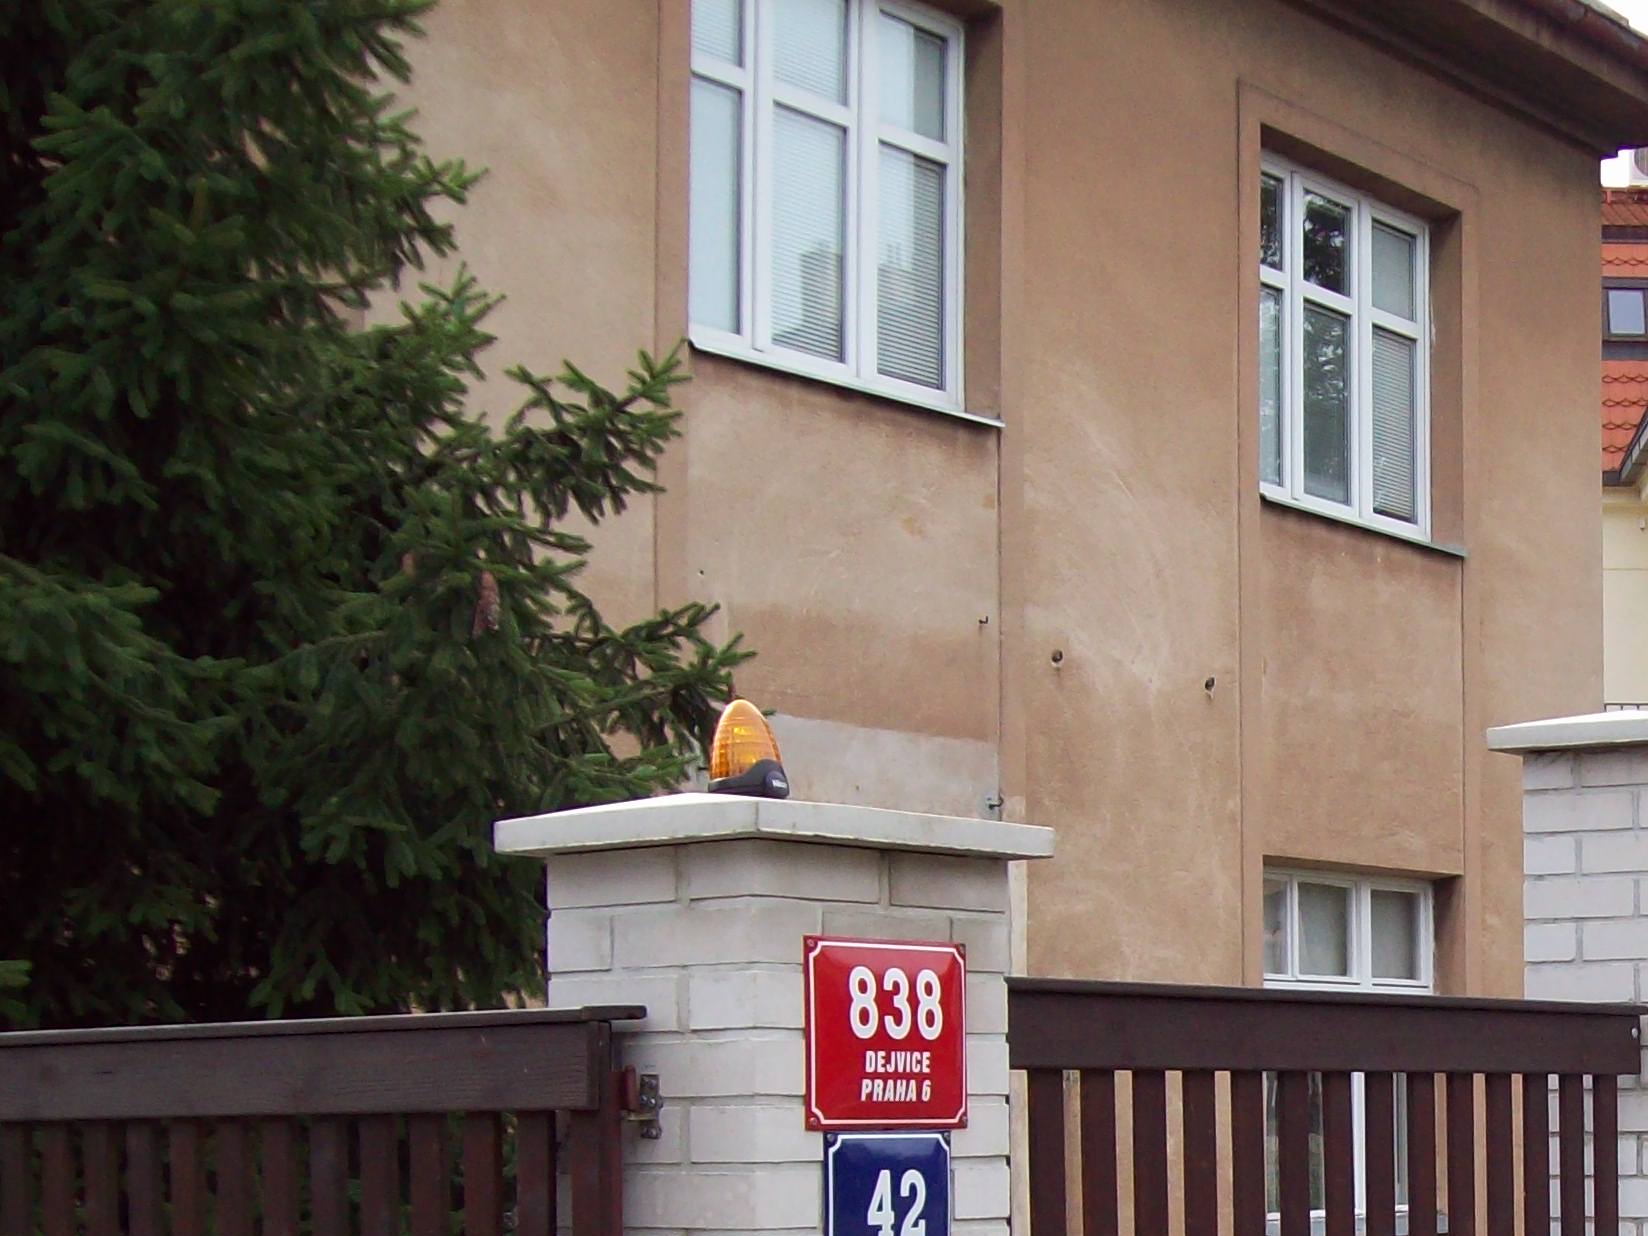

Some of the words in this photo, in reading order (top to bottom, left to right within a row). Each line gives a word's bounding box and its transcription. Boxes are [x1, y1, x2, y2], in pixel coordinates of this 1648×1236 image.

[849, 966, 943, 1040] 838
[865, 1051, 931, 1073] DEJVICE
[861, 1079, 917, 1102] PRAHA
[921, 1080, 932, 1102] 6
